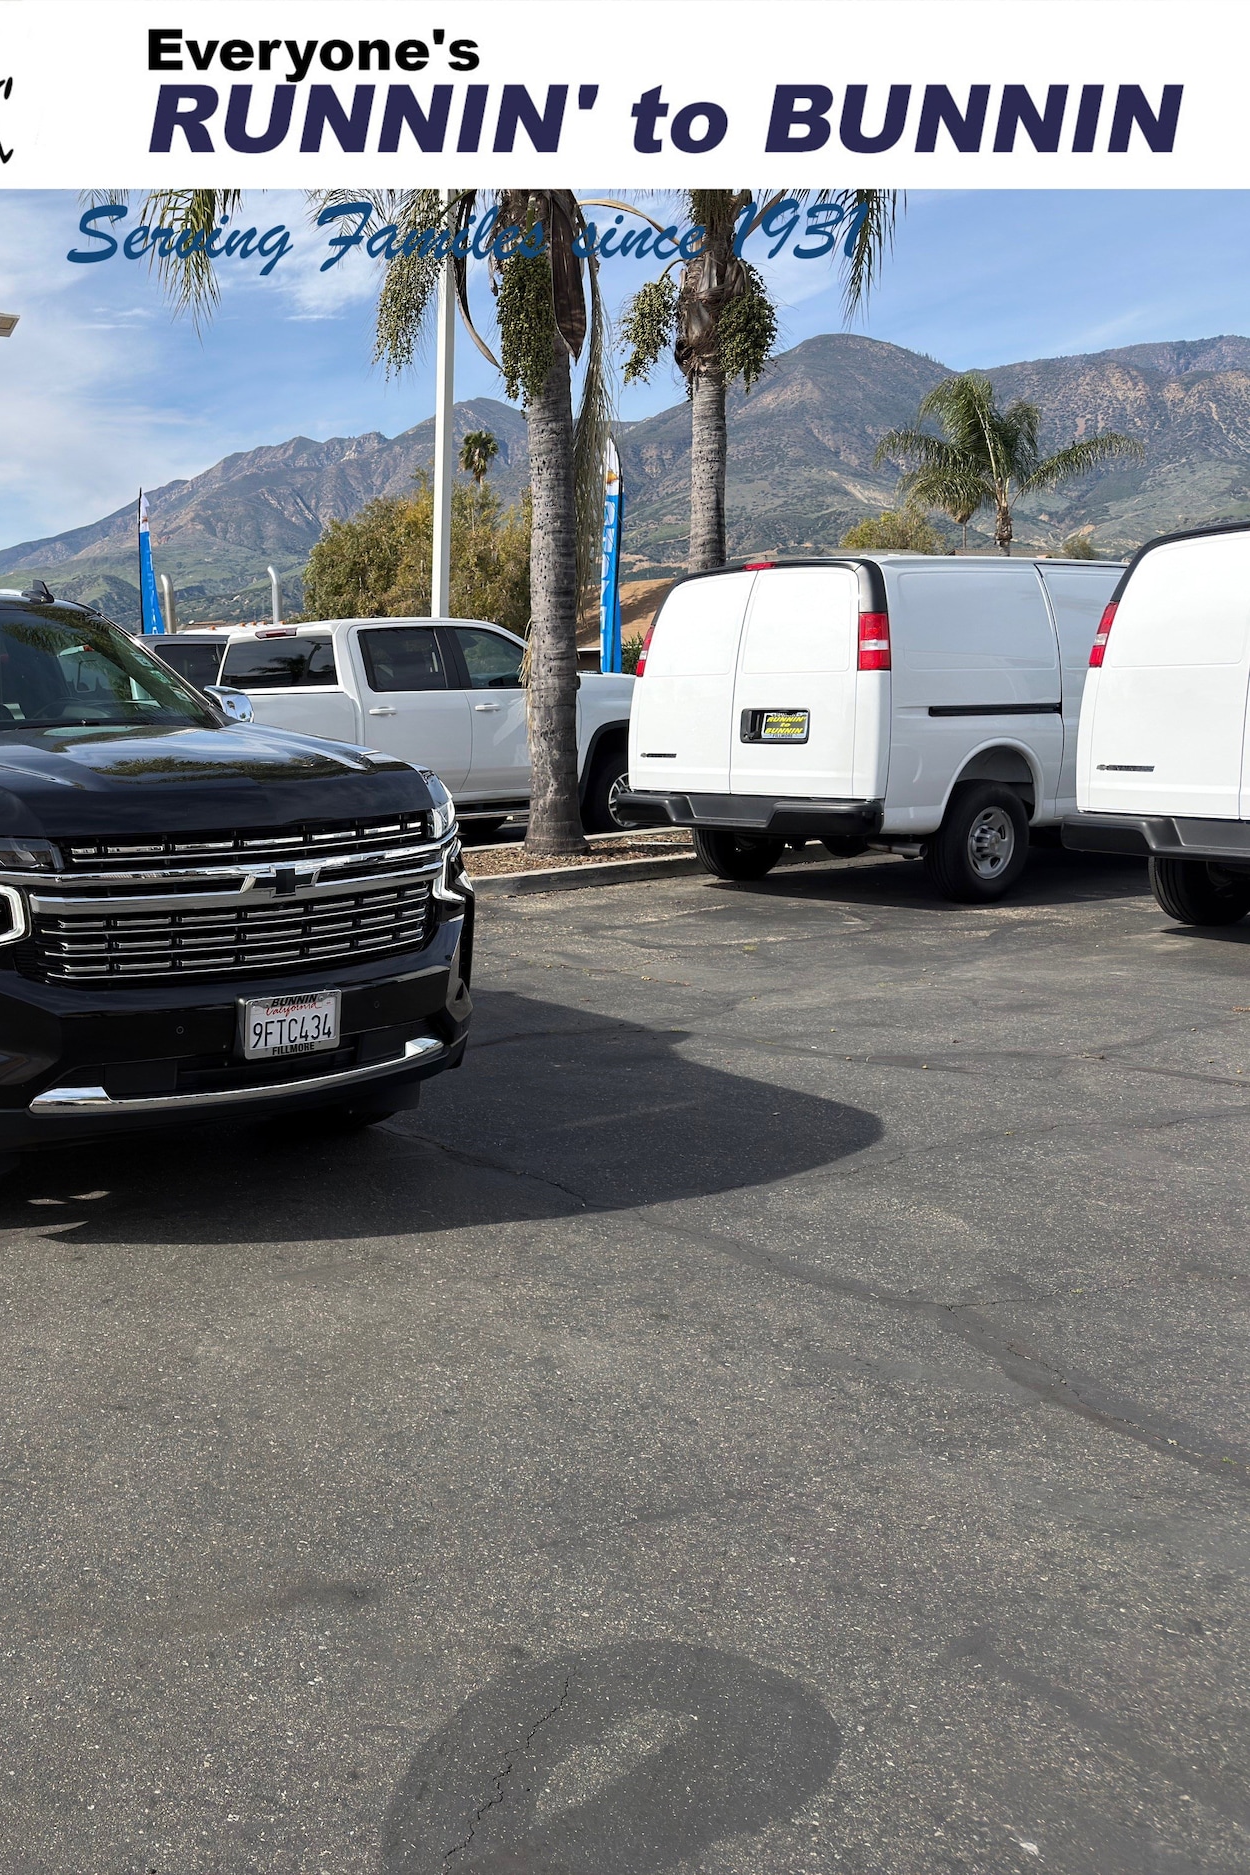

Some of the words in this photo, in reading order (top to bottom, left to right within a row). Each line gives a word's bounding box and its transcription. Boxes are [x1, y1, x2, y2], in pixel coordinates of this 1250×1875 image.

[270, 993, 318, 1007] BUNNIN
[265, 1002, 322, 1017] California
[252, 1013, 332, 1049] 9FTC434
[272, 1041, 315, 1056] FILLMORE
